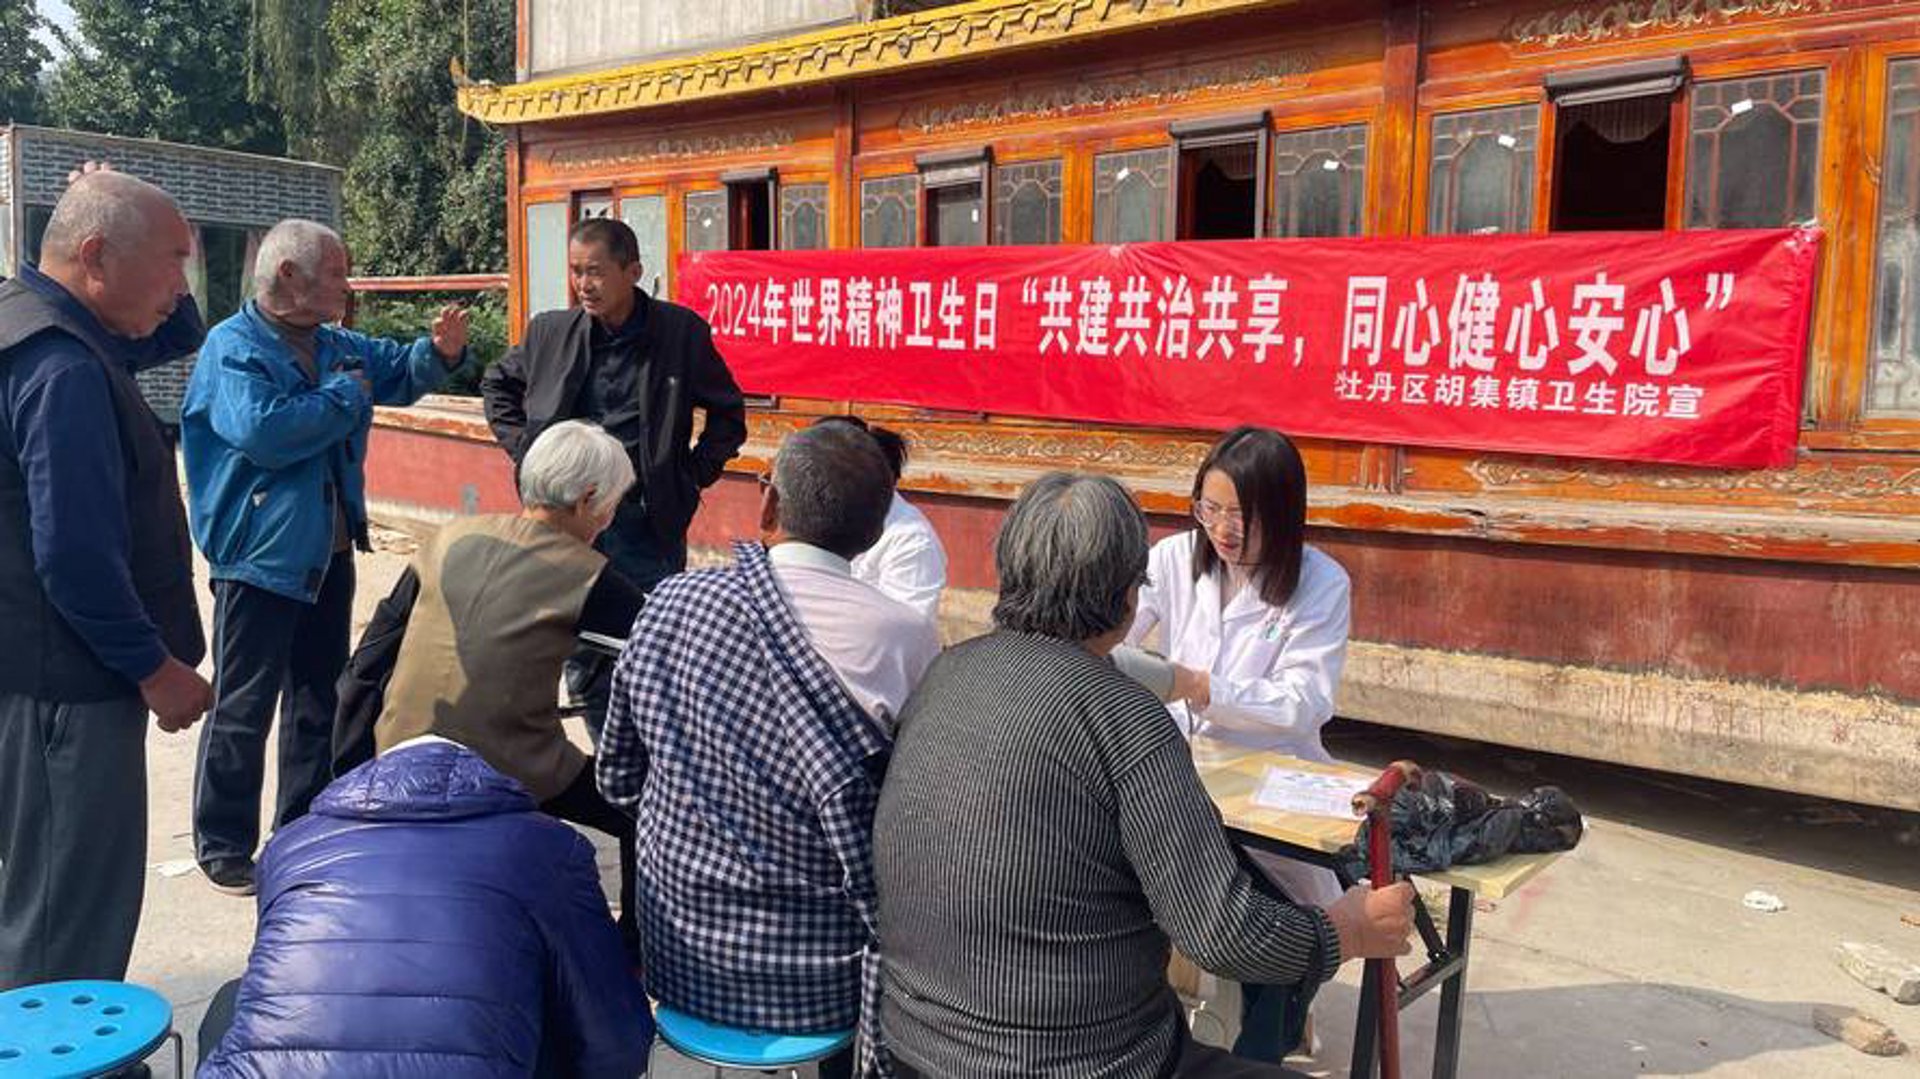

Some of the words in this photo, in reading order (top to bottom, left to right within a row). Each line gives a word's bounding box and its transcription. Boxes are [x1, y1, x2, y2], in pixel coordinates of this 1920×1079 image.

[1334, 371, 1704, 419] 牡丹区胡集镇卫生院宣
